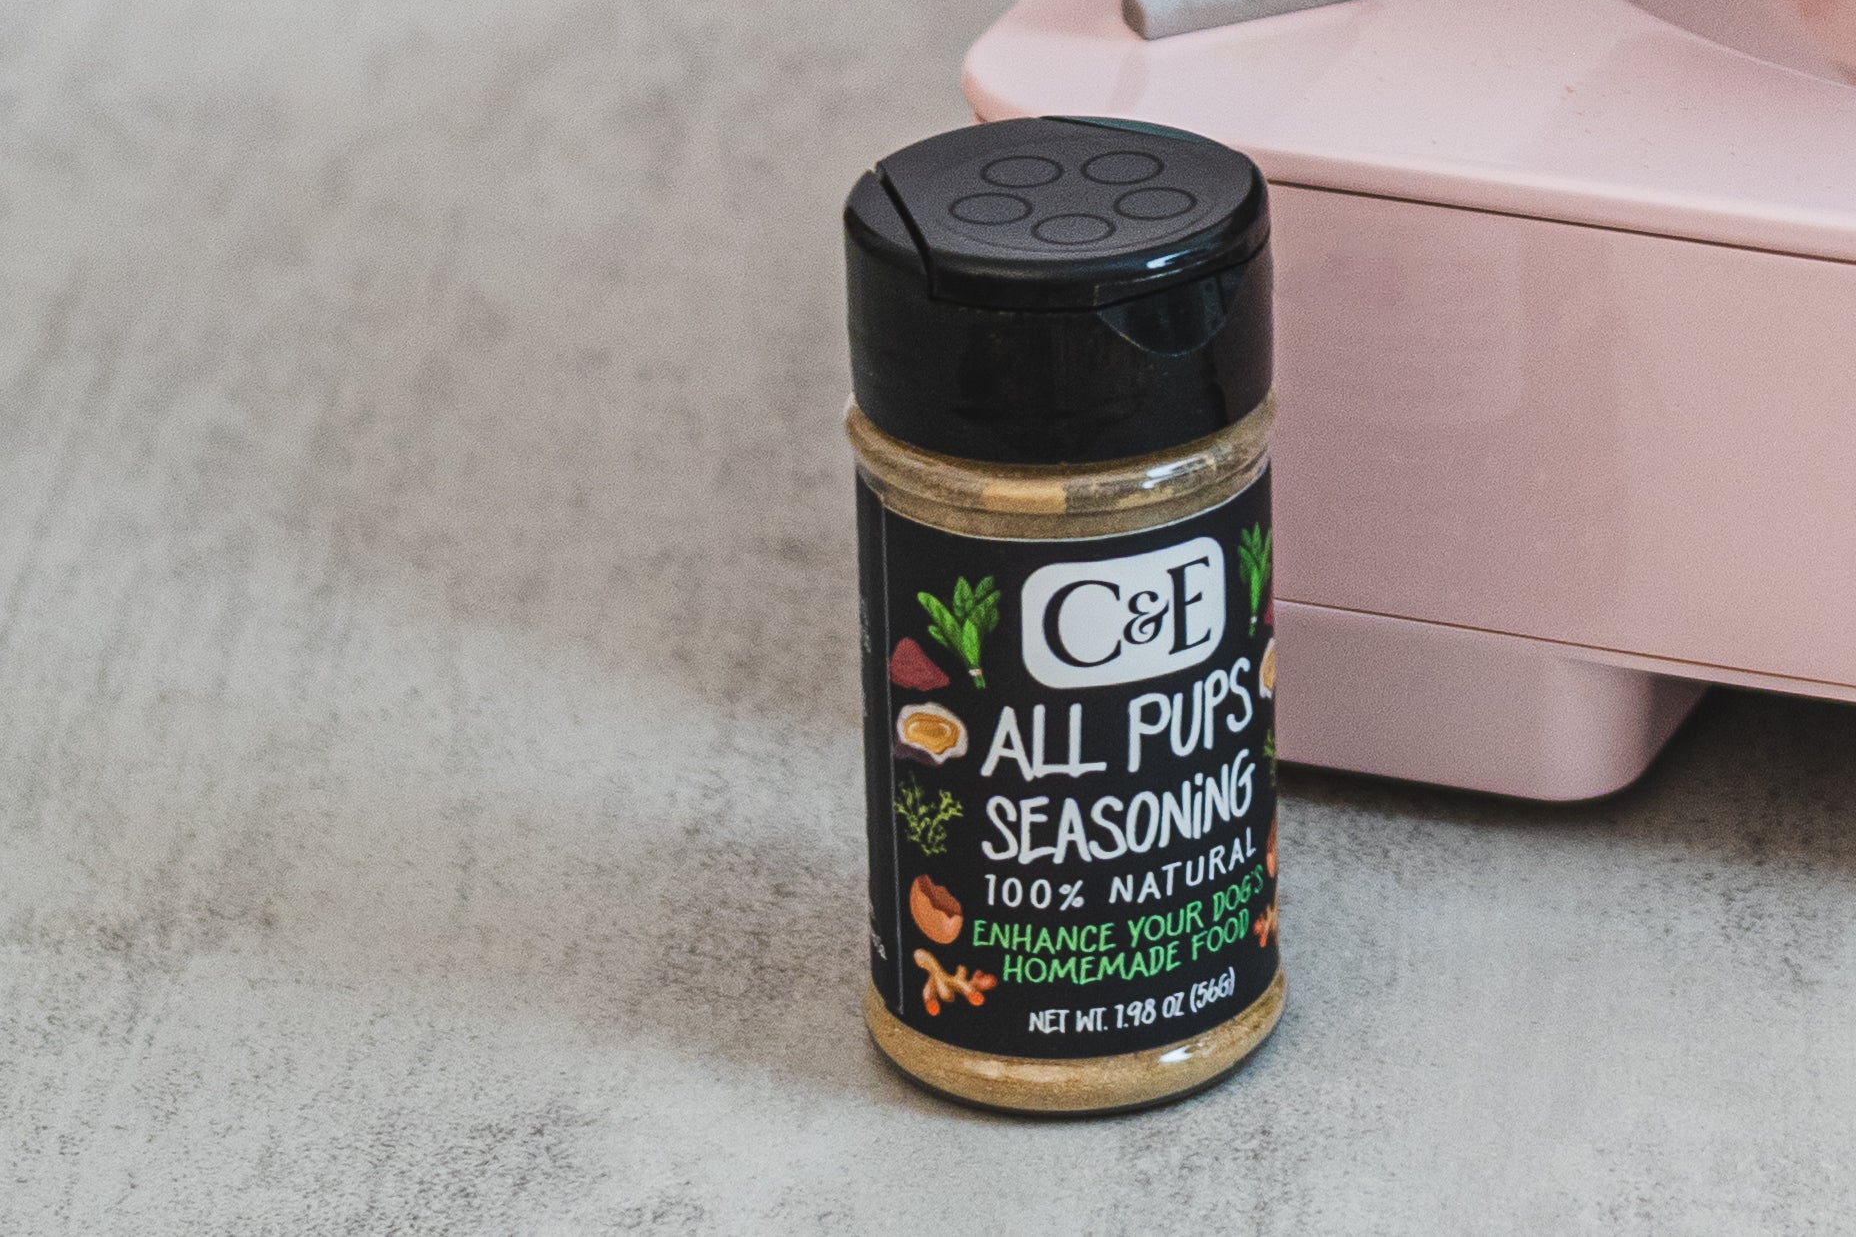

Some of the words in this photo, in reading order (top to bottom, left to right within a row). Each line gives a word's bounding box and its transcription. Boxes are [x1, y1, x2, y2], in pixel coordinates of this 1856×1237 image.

[1042, 556, 1211, 668] C&E
[980, 703, 1107, 781] ALL
[1128, 657, 1253, 772] PUPS
[984, 874, 1085, 910] 100%
[1109, 827, 1257, 904] NATURAL
[973, 919, 1116, 954] ENHANCE
[1127, 900, 1204, 948] YOUR
[1003, 940, 1182, 985] HOMEMADE
[1191, 908, 1250, 961] FOOD
[1028, 1009, 1070, 1034] NET
[1076, 1007, 1109, 1032] WT.
[1114, 998, 1156, 1029] 1.98
[1162, 992, 1185, 1018] OZ
